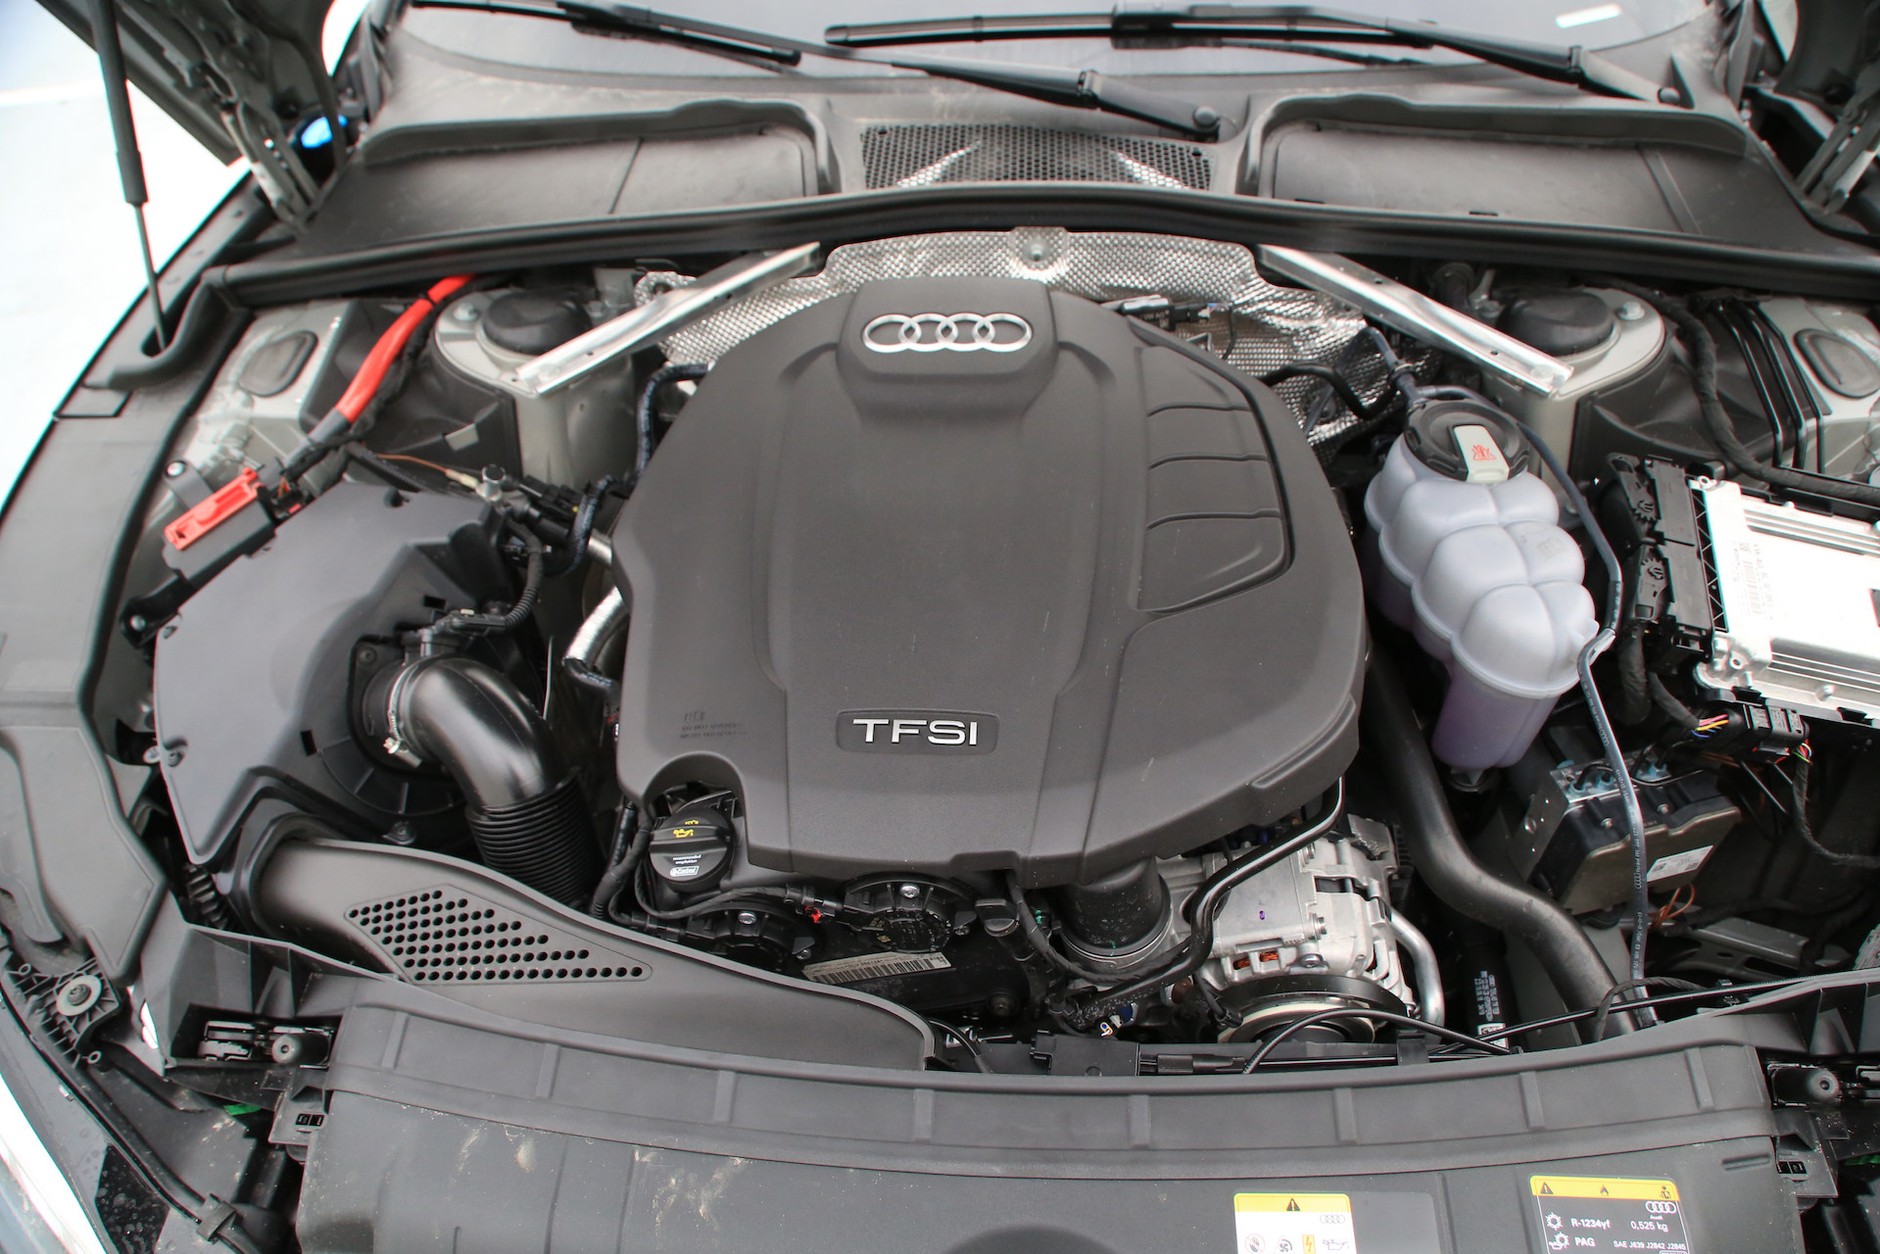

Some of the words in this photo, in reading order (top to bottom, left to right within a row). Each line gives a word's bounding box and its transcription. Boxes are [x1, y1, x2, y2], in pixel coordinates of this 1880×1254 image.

[853, 719, 978, 745] TFSI
[1571, 1218, 1611, 1230] R-1234yf
[1657, 1221, 1668, 1232] kg
[1575, 1237, 1595, 1247] PAG
[1613, 1240, 1628, 1248] SAE
